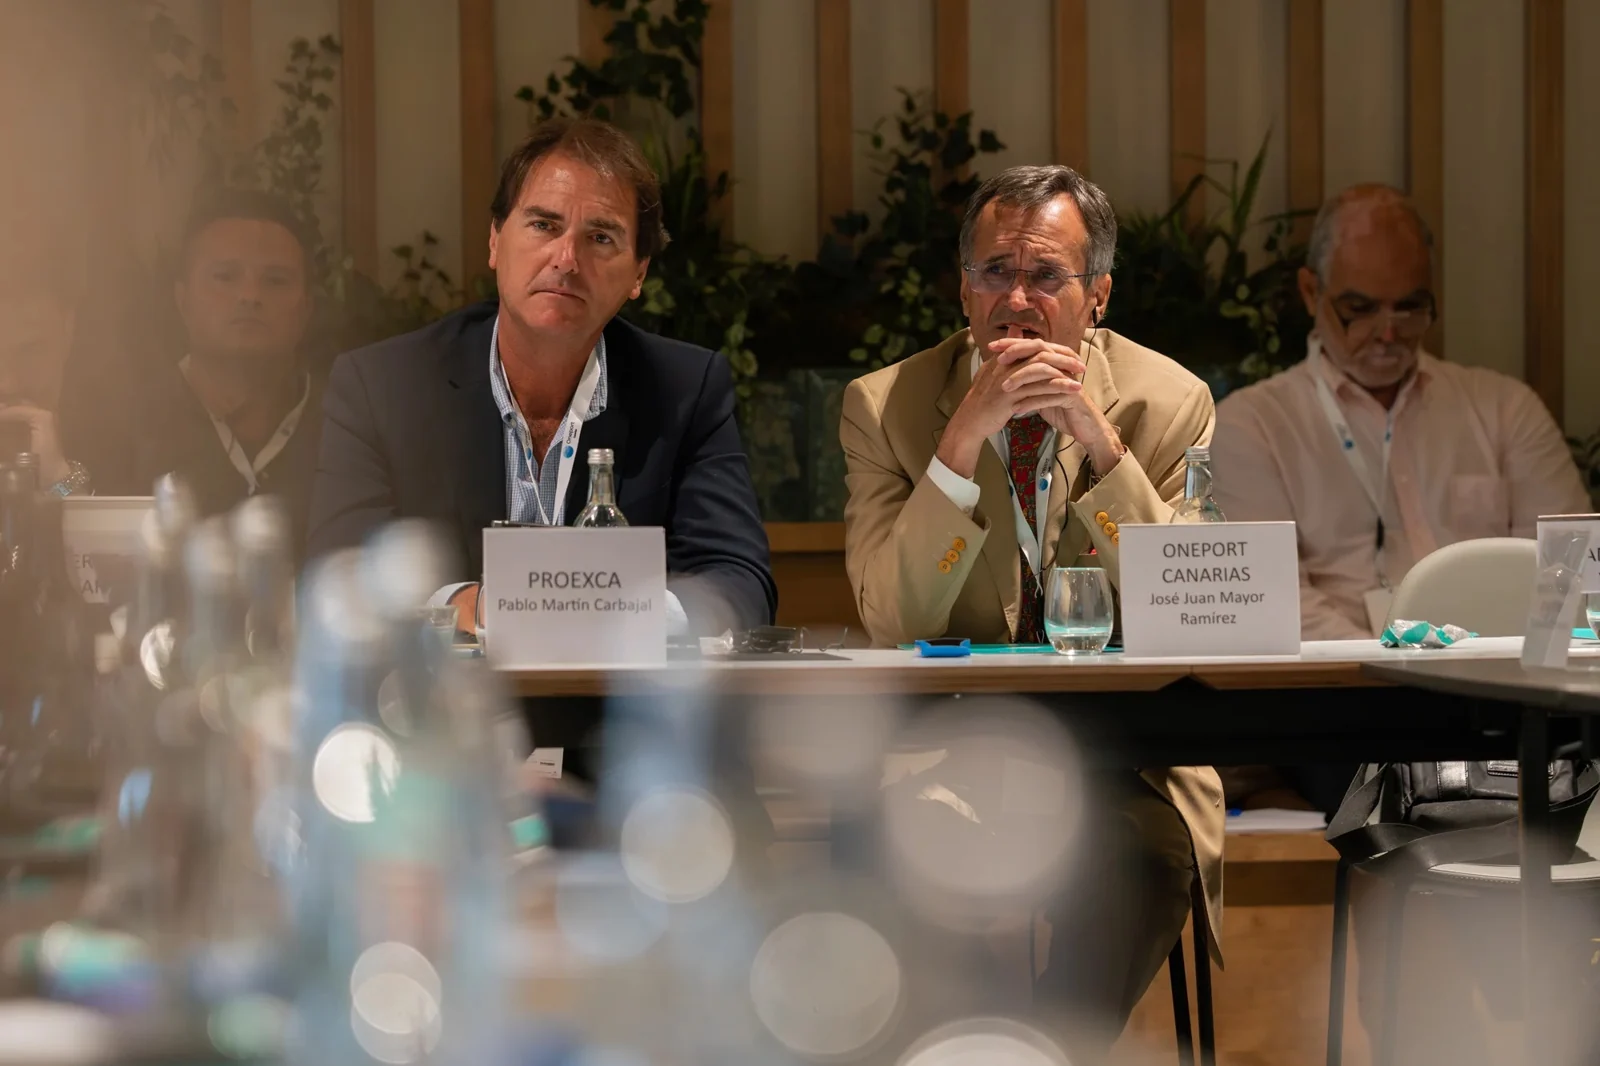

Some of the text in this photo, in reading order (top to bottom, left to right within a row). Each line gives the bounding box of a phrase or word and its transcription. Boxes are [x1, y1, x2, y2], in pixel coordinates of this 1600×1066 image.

[1163, 541, 1248, 558] ONEPORT
[528, 571, 622, 589] PROEXCA
[1162, 567, 1251, 583] CANARIAS
[498, 599, 652, 613] Pablo Martín Carbajal
[1149, 591, 1265, 606] José Juan Mayor
[1180, 611, 1237, 625] Ramírez
